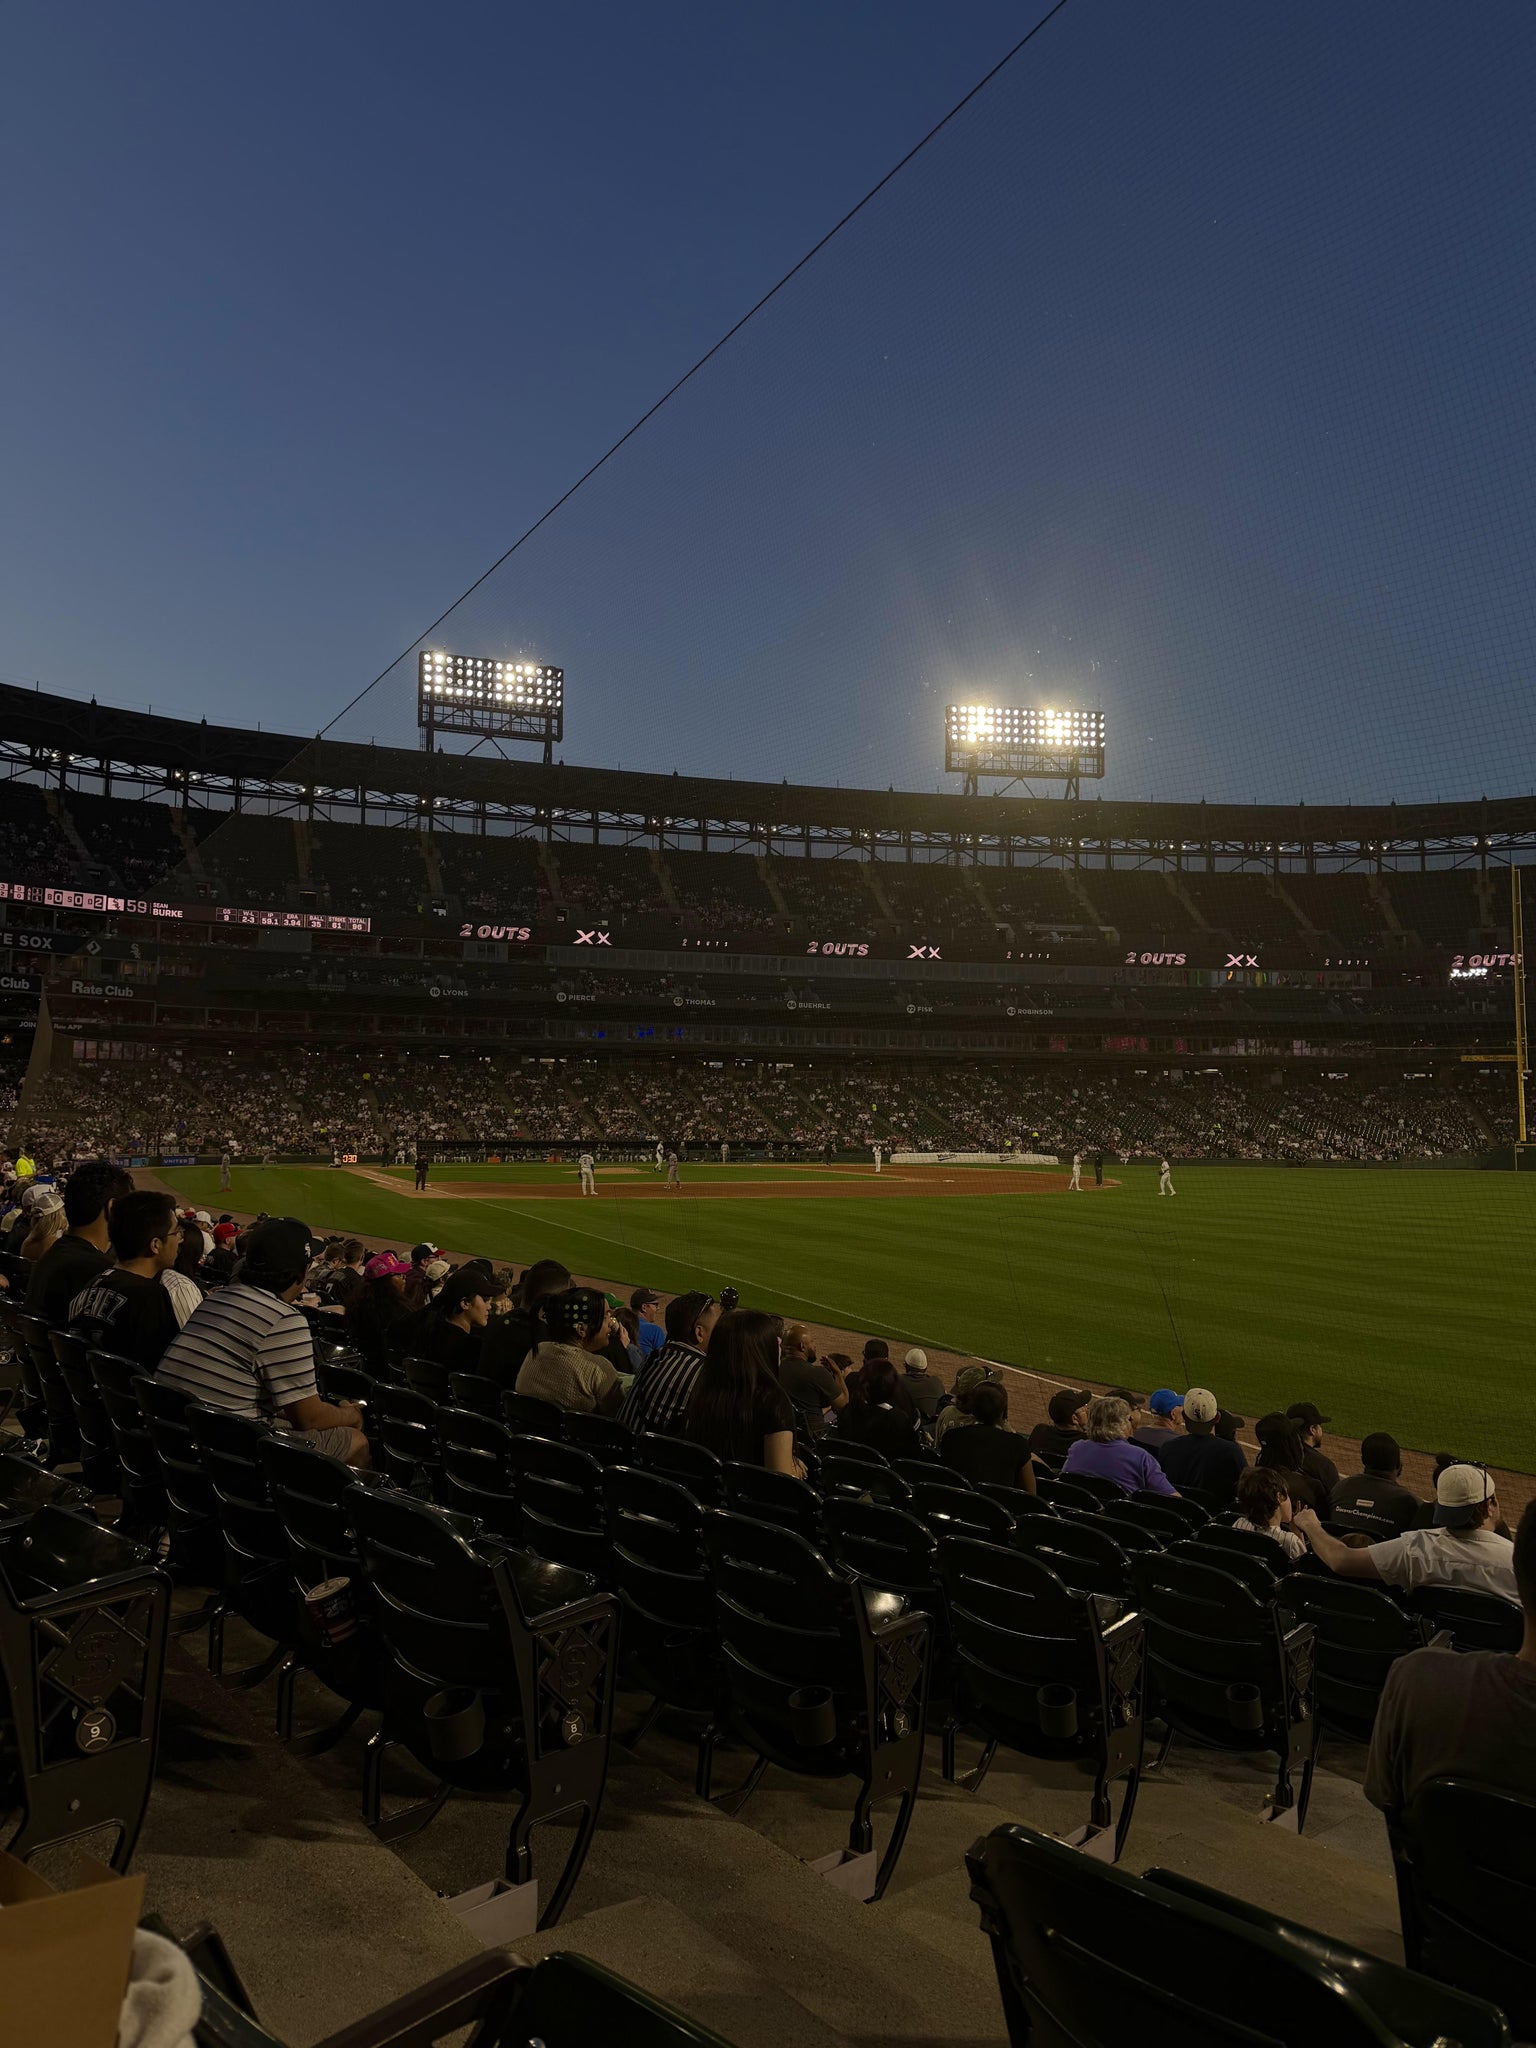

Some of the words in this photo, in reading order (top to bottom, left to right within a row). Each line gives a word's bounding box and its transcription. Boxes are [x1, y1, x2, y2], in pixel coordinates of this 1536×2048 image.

[54, 892, 62, 904] 0
[74, 894, 82, 906] 0
[95, 897, 103, 908] 2
[126, 900, 147, 914] 59
[152, 909, 183, 918] BURKE
[261, 918, 279, 926] 59.1
[459, 923, 473, 937] 2
[476, 924, 532, 941] OUTS
[19, 935, 53, 950] SOX
[806, 941, 819, 955] 2
[821, 941, 870, 957] OUTS
[1125, 951, 1136, 964] 2
[1140, 952, 1187, 966] OUTS
[1451, 954, 1465, 968] 2
[0, 977, 30, 990] Club
[71, 980, 103, 995] Rate
[104, 985, 134, 998] Club
[442, 989, 469, 997] LYONS
[568, 993, 596, 1002] PIERCE
[685, 999, 716, 1007] THOMAS
[798, 1002, 831, 1010] BUEHRLE
[1017, 1008, 1053, 1016] ROBINSON
[90, 1726, 101, 1738] 9
[570, 1723, 578, 1733] 8
